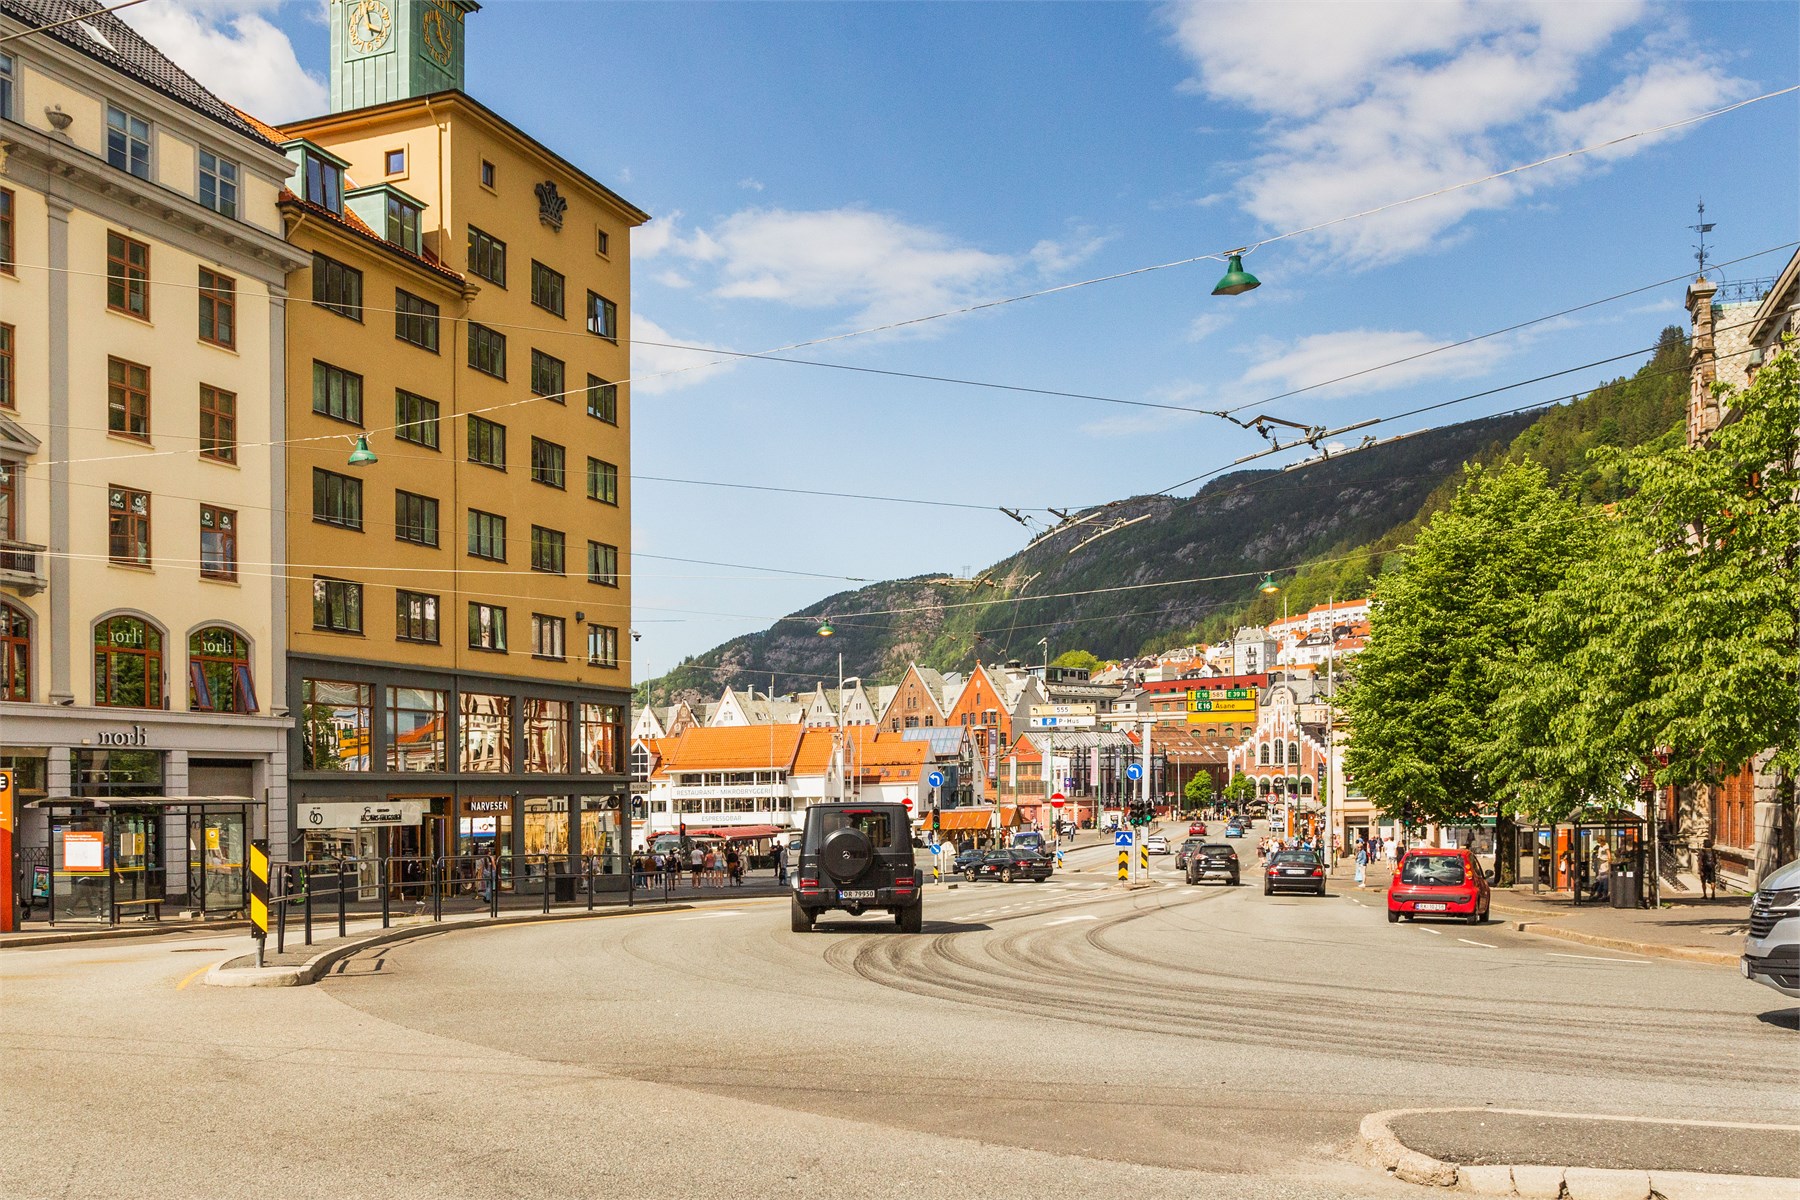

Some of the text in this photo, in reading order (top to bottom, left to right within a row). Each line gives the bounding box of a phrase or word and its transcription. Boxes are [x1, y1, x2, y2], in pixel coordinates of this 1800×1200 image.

[99, 725, 149, 746] norli
[720, 787, 771, 795] MIKROBRYGGERI
[470, 801, 508, 811] NARVESEN
